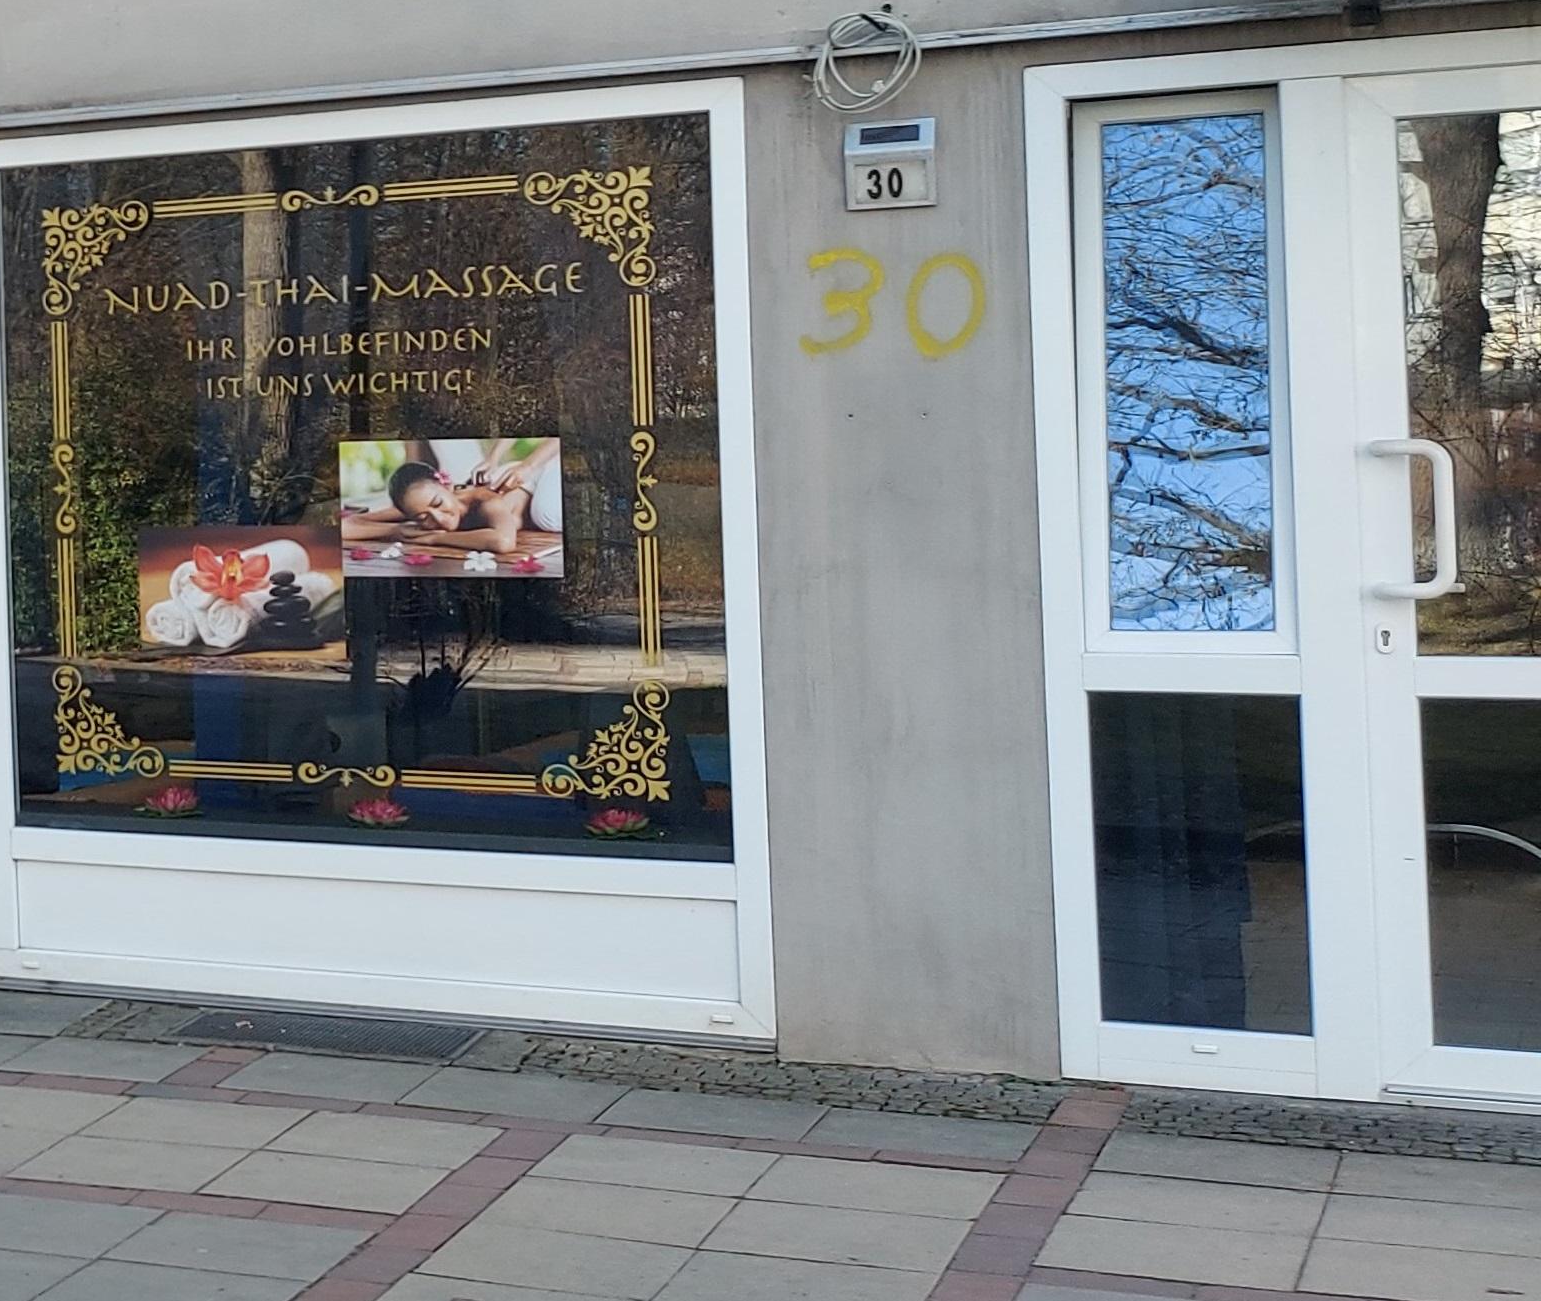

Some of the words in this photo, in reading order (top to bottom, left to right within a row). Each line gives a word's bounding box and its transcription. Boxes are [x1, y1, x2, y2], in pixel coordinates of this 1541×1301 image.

[867, 167, 904, 200] 30
[104, 261, 585, 316] NUAD-THAI-MASSAGE
[798, 247, 987, 360] 30
[185, 337, 237, 361] IHR
[247, 328, 492, 358] WOHLBEFINDEN
[206, 375, 244, 400] IST
[256, 373, 314, 398] UNS
[322, 368, 473, 396] WICHTIG!
